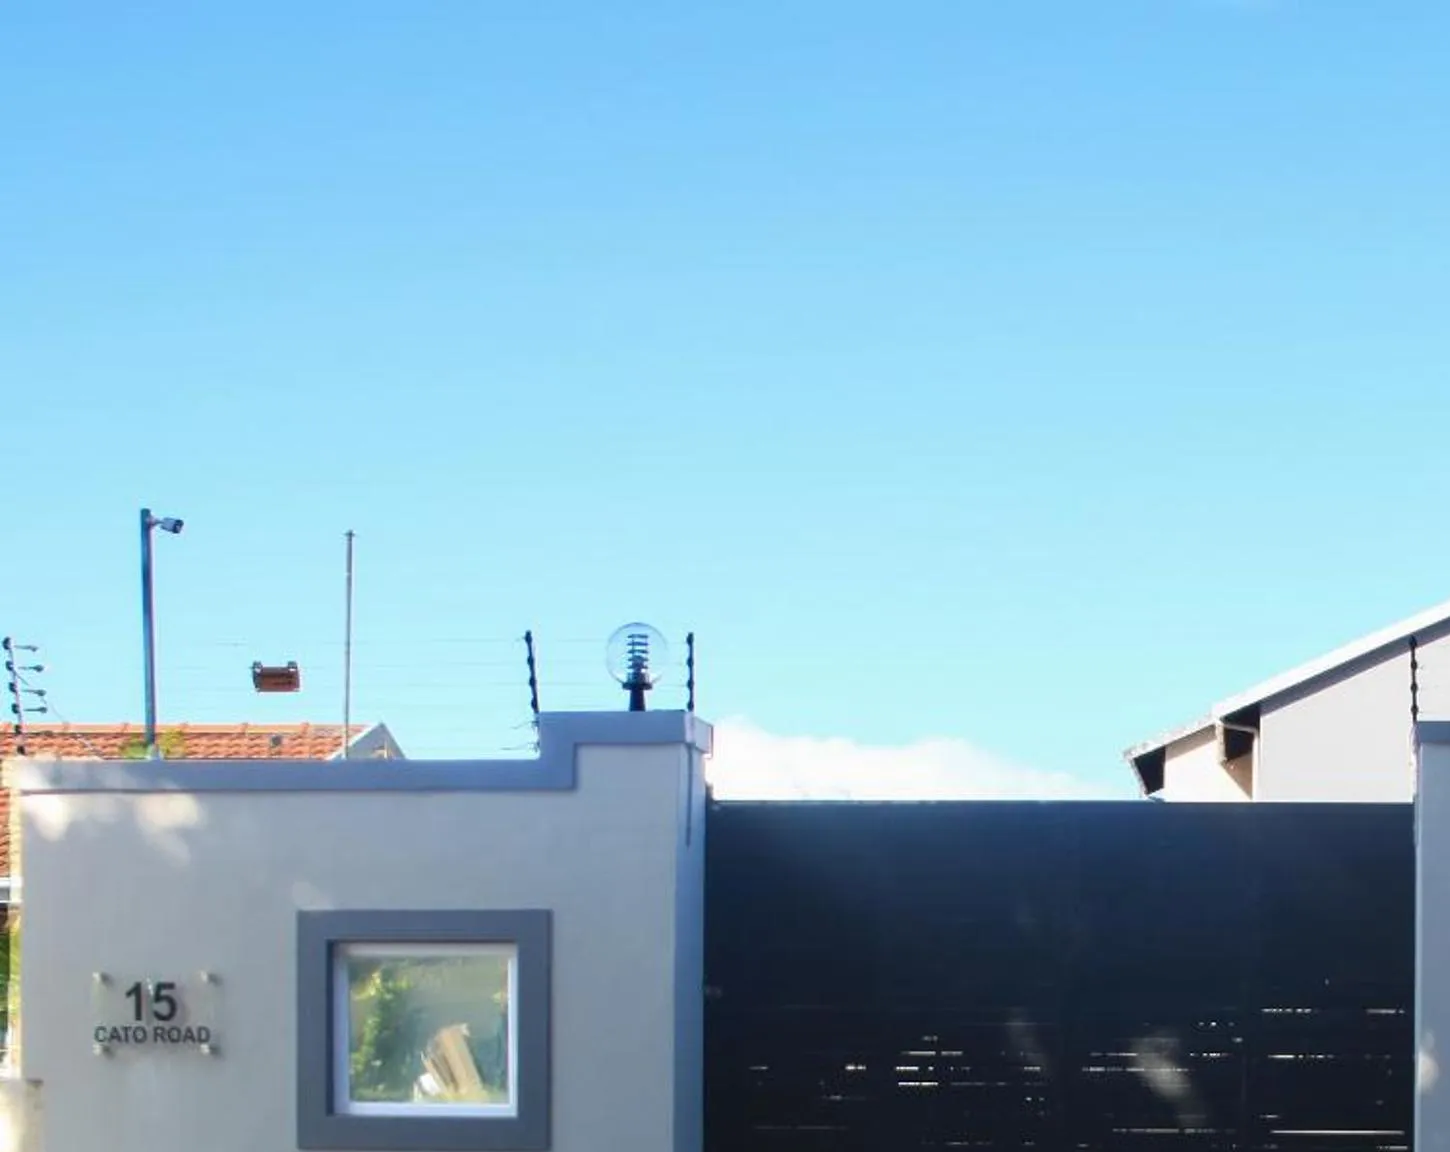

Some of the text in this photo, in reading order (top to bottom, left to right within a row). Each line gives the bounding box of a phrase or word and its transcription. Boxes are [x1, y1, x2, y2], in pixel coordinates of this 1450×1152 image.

[125, 981, 178, 1022] 15
[93, 1026, 212, 1044] CATO ROAD
